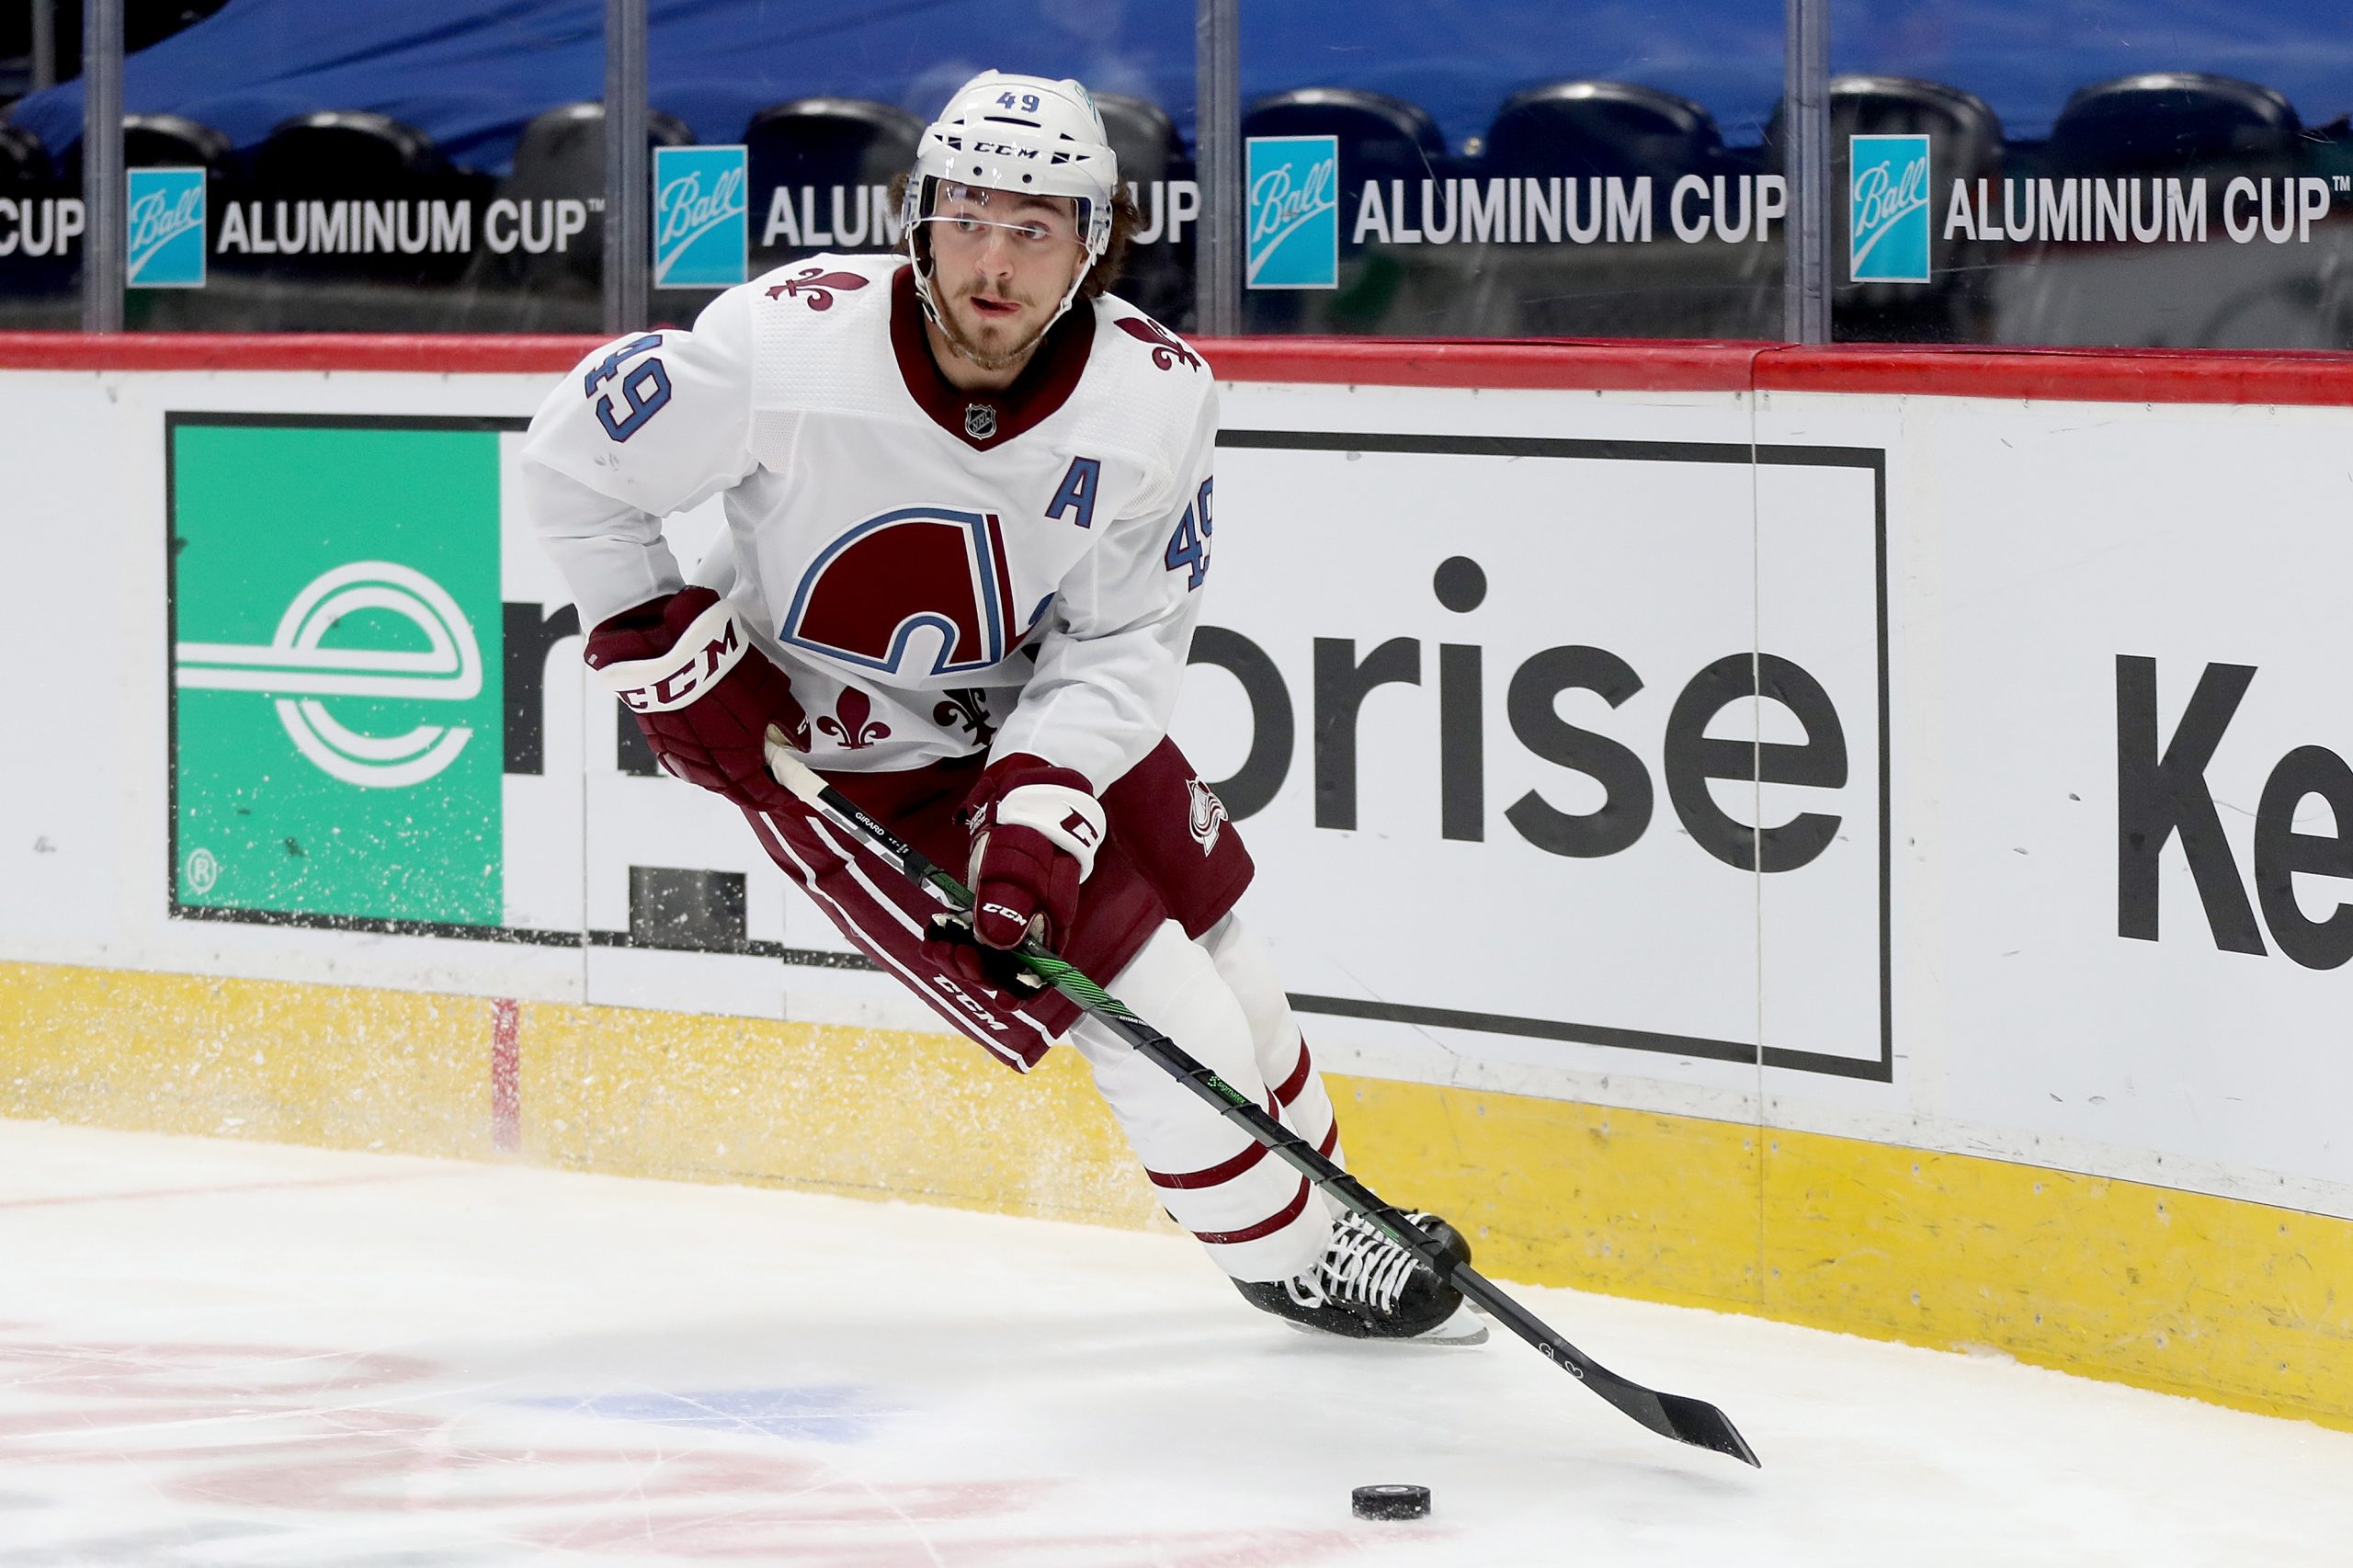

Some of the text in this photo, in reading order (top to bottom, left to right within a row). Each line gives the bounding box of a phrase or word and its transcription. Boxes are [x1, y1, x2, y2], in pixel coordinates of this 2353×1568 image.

[995, 91, 1040, 113] 49
[973, 141, 1040, 160] CCM
[130, 186, 203, 252] Ball
[215, 199, 472, 255] ALUMINUM
[659, 164, 746, 246] Ball
[1127, 180, 1202, 245] UP
[1252, 157, 1335, 244] Ball
[1352, 174, 1788, 244] ALUMINUM CUP
[1854, 156, 1929, 237] Ball
[1943, 177, 2207, 243] ALUMINUM
[584, 334, 672, 443] 49
[1044, 455, 1102, 530] A
[614, 616, 739, 710] CCM
[855, 812, 885, 835] GIRARD
[982, 903, 1028, 926] CCM
[933, 972, 1009, 1030] CCM
